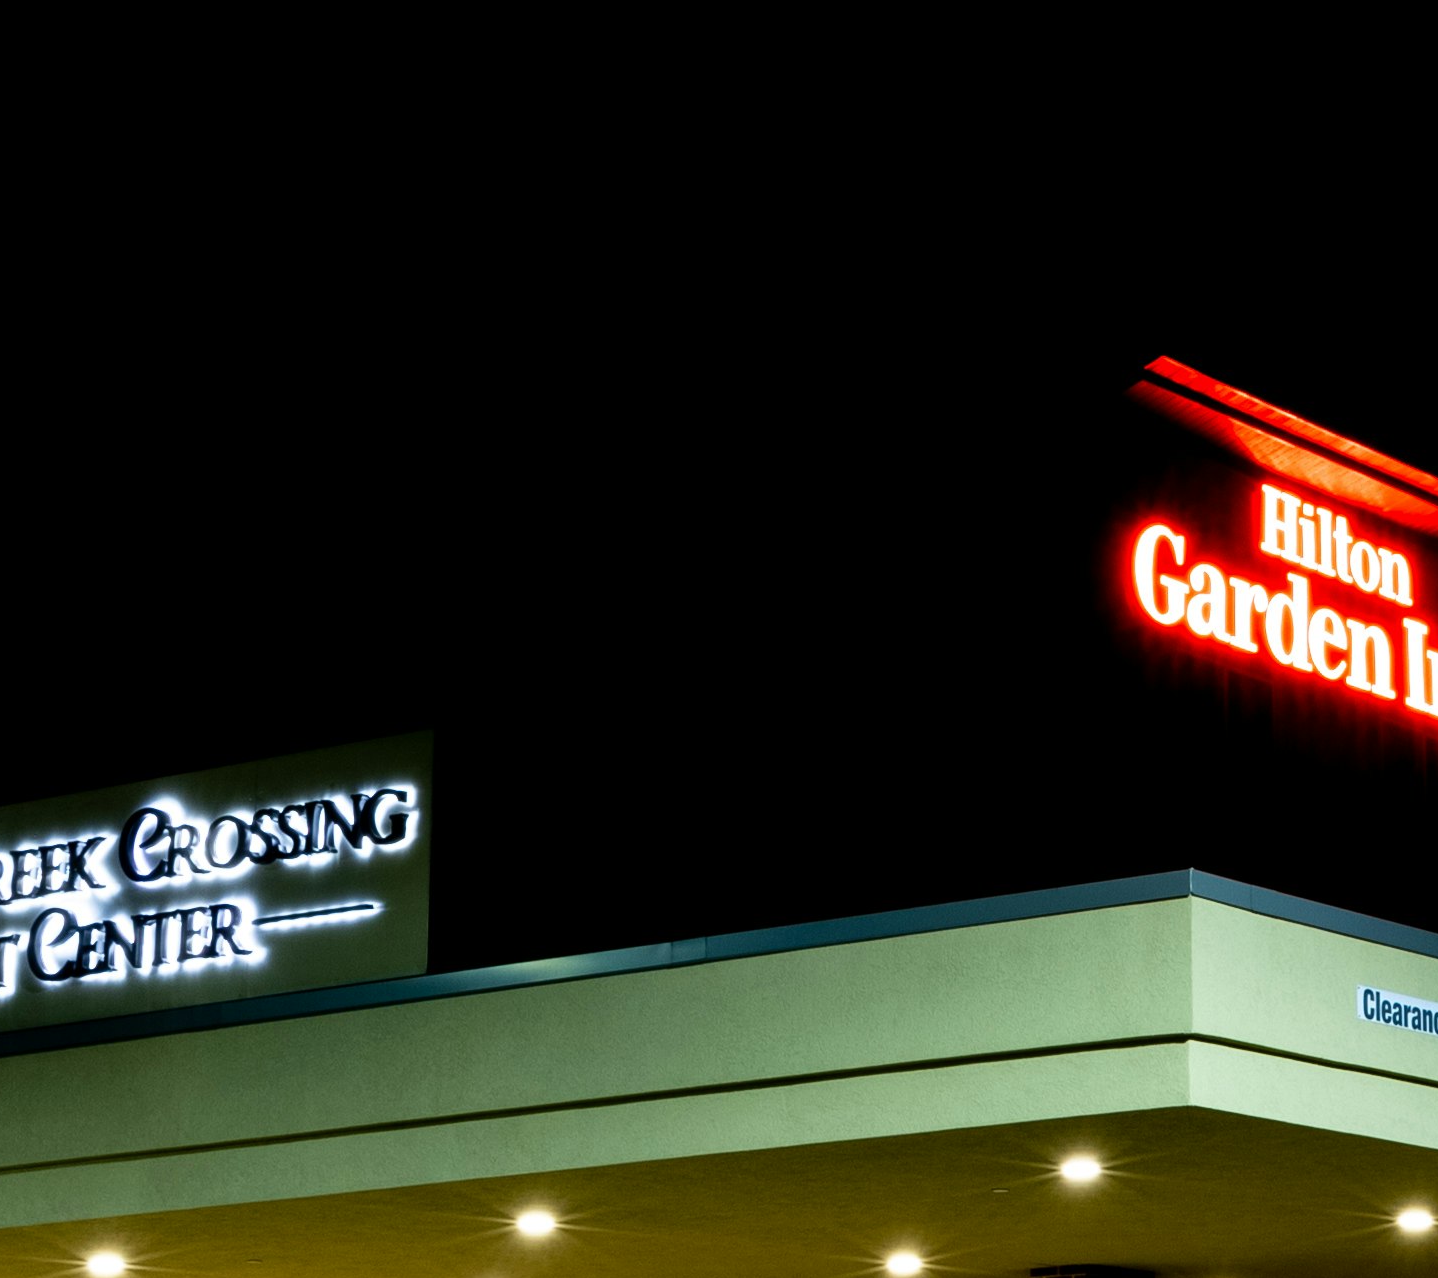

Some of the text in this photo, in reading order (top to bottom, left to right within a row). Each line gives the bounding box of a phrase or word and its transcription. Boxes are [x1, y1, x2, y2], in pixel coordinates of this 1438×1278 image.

[1260, 483, 1413, 607] Hilton
[1133, 523, 1396, 700] Garden
[118, 788, 409, 882] CROSSING
[27, 903, 253, 981] CENTER
